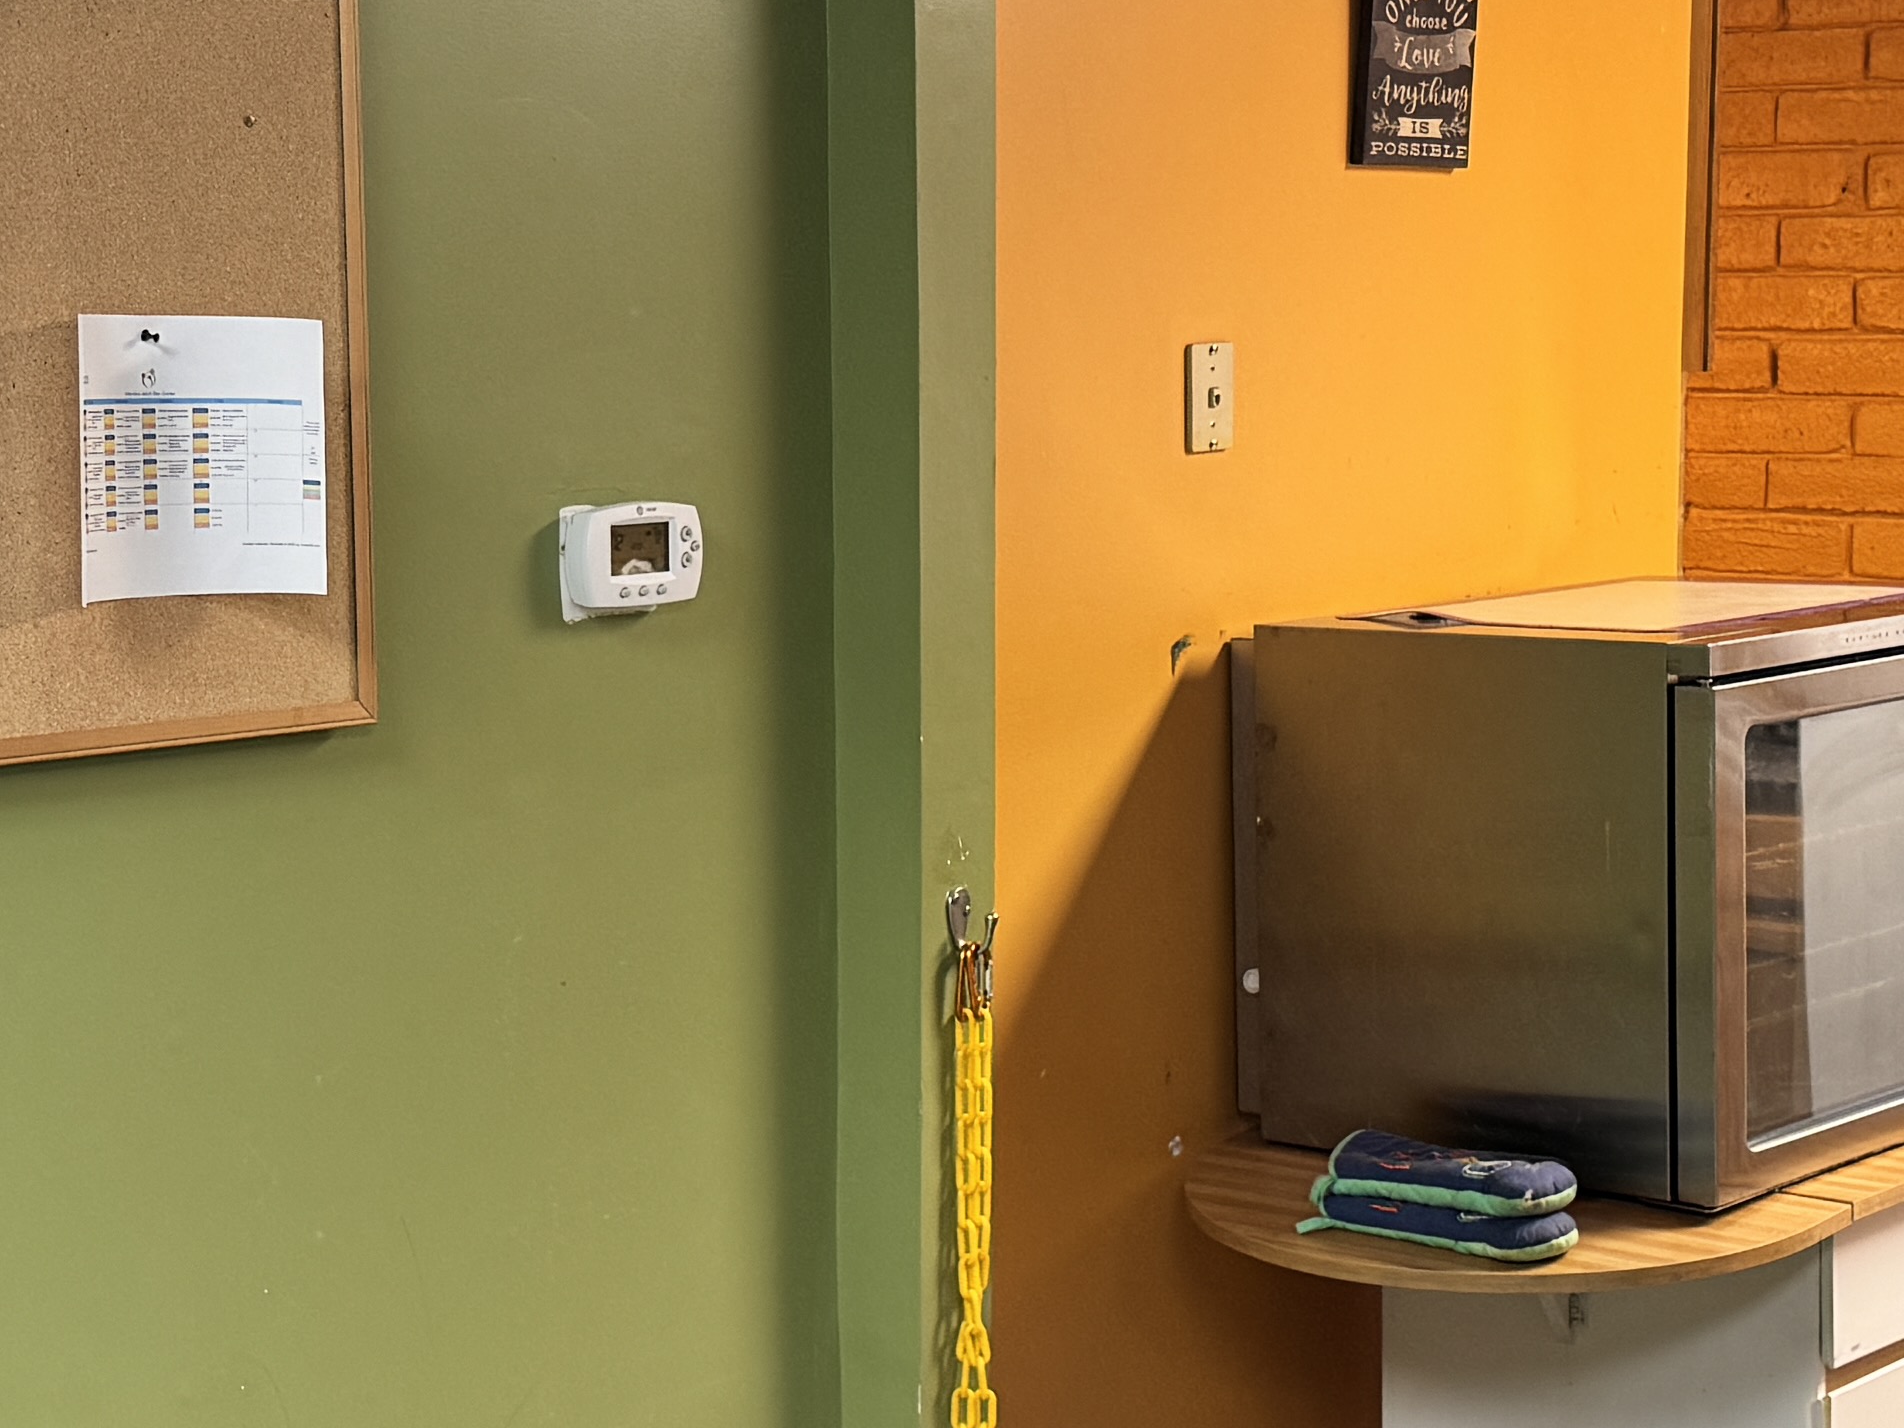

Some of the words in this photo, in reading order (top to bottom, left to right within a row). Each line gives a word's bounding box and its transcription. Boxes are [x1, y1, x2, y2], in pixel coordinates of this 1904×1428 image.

[1406, 8, 1447, 30] choose
[1398, 37, 1441, 70] Love
[1372, 75, 1469, 114] Anything
[1412, 121, 1430, 134] IS
[1370, 141, 1467, 159] POSSIBLE
